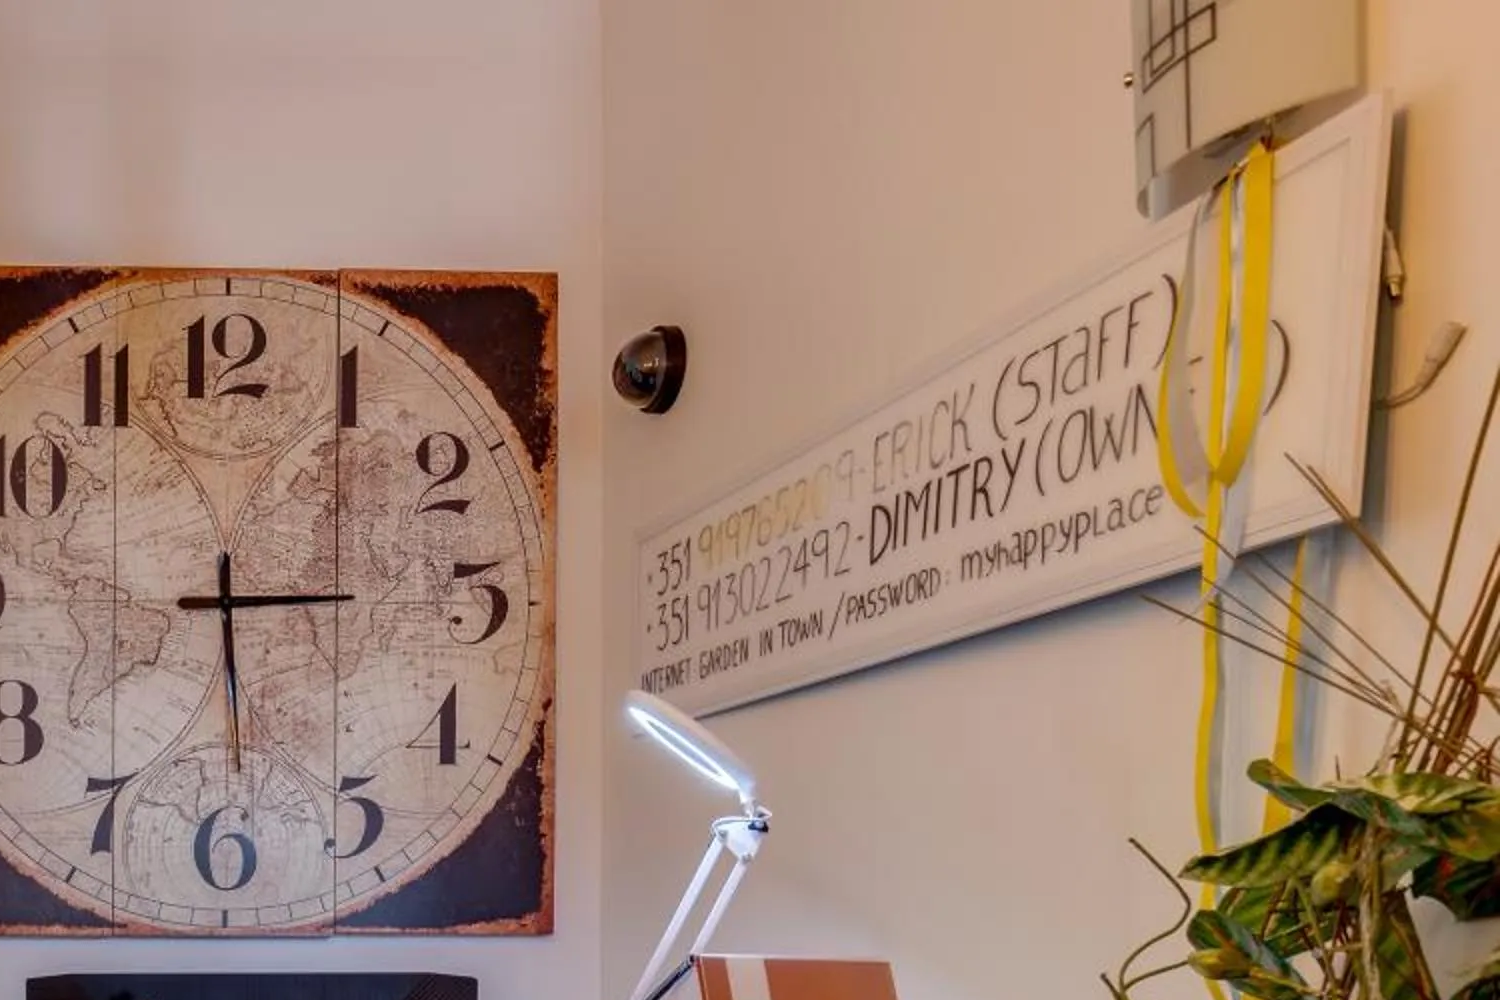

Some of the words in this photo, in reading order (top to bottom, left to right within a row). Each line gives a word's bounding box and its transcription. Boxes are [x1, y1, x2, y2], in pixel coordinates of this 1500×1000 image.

[79, 343, 130, 428] 11
[184, 313, 267, 399] 12
[339, 345, 361, 428] 1
[414, 432, 471, 515] 2
[656, 593, 690, 652] 351
[870, 438, 1026, 566] DIMITRY
[656, 536, 691, 597] 351
[699, 637, 750, 680] GARDEN
[759, 627, 774, 657] IN
[778, 608, 824, 648] TOWN
[405, 683, 471, 766] 4
[86, 776, 134, 855] 7
[193, 806, 257, 890] 6
[323, 776, 385, 858] 5
